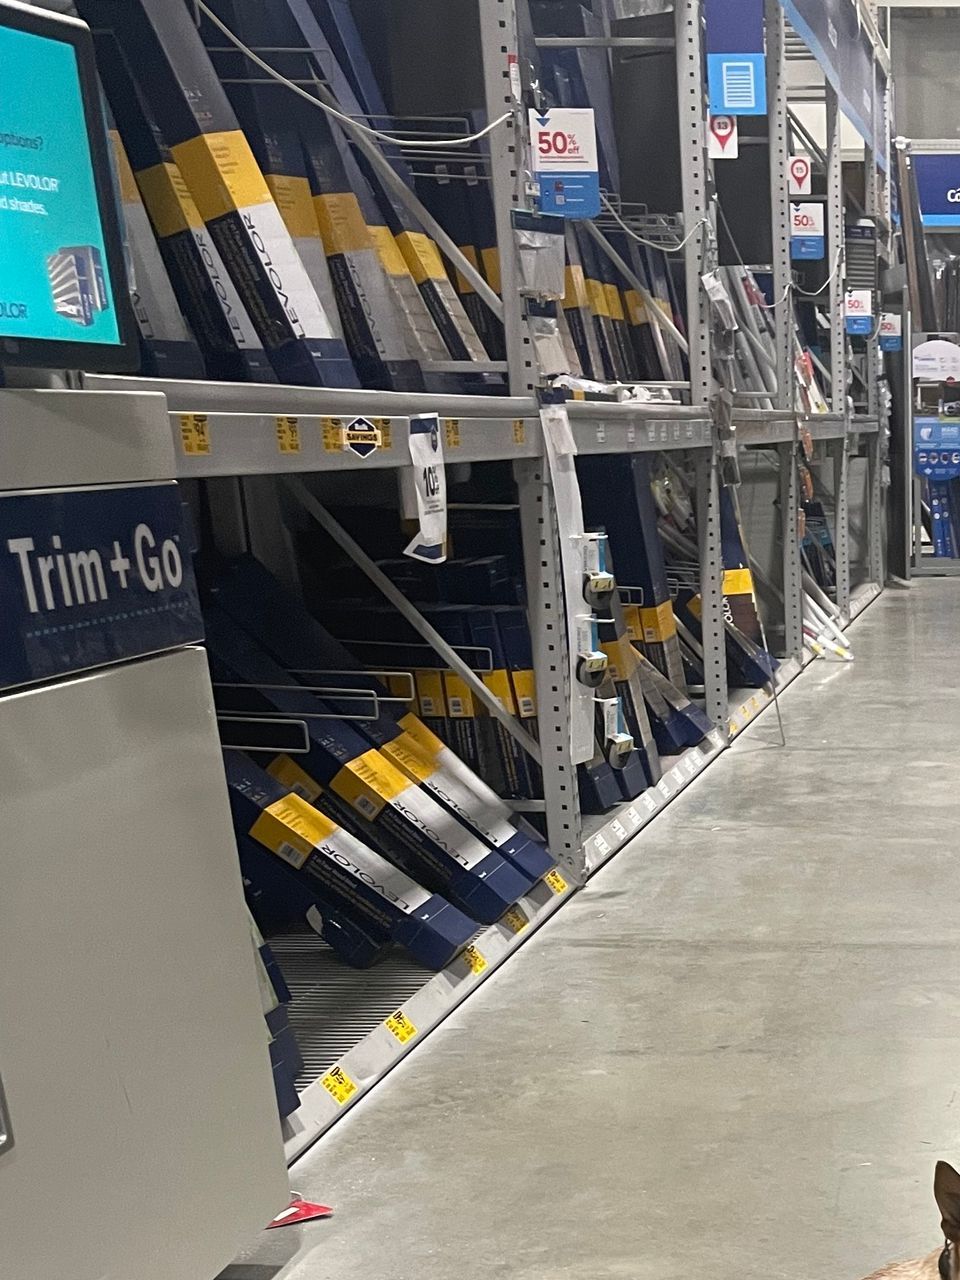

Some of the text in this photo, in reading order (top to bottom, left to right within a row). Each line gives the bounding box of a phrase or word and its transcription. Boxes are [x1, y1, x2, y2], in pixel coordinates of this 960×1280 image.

[10, 171, 60, 193] LEVOLOR
[195, 233, 246, 344] LEVOLOR
[243, 213, 307, 338] LEVOLOR
[346, 433, 378, 442] SAVINGS
[393, 800, 470, 867] LEVOLOR
[427, 780, 499, 844] LEVOLOR
[321, 843, 411, 912] LEVOLOR
